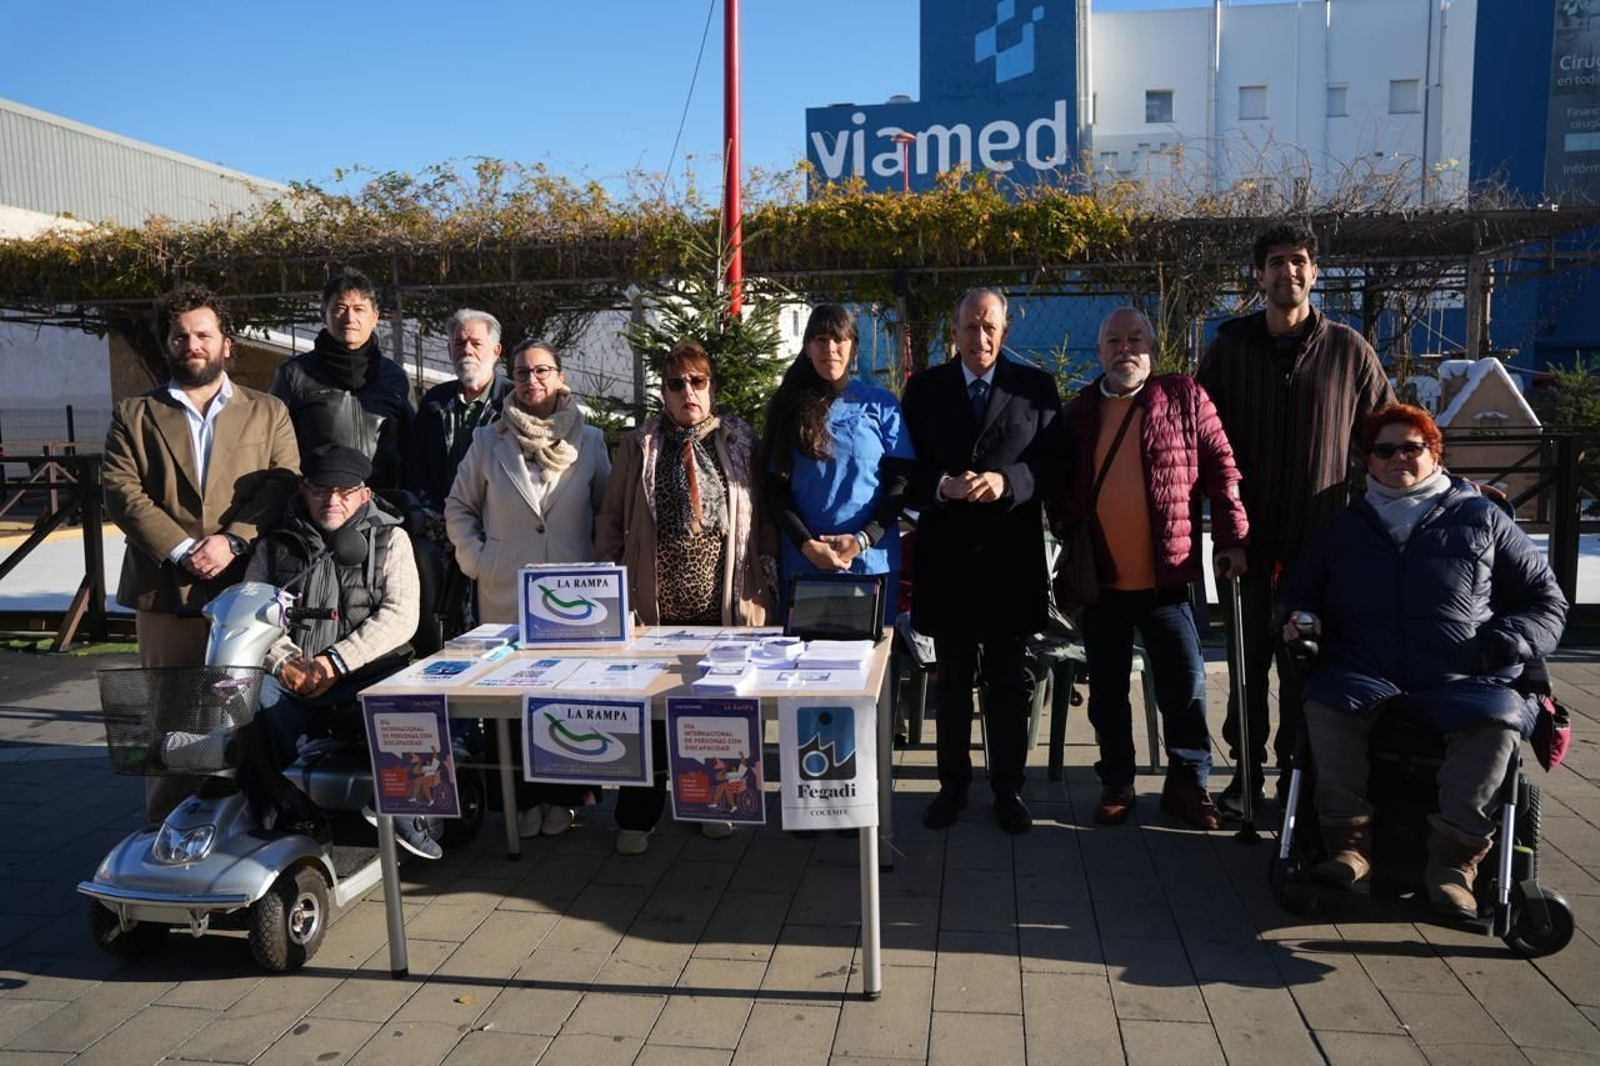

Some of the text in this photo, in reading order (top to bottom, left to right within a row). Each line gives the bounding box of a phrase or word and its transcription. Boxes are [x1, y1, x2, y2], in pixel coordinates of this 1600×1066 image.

[1557, 77, 1572, 87] en
[810, 99, 1067, 179] viamed
[556, 579, 609, 588] LA RAMPA
[567, 708, 628, 721] LA RAMPA
[797, 783, 857, 800] Fegadi
[810, 809, 849, 817] COCEMFE
